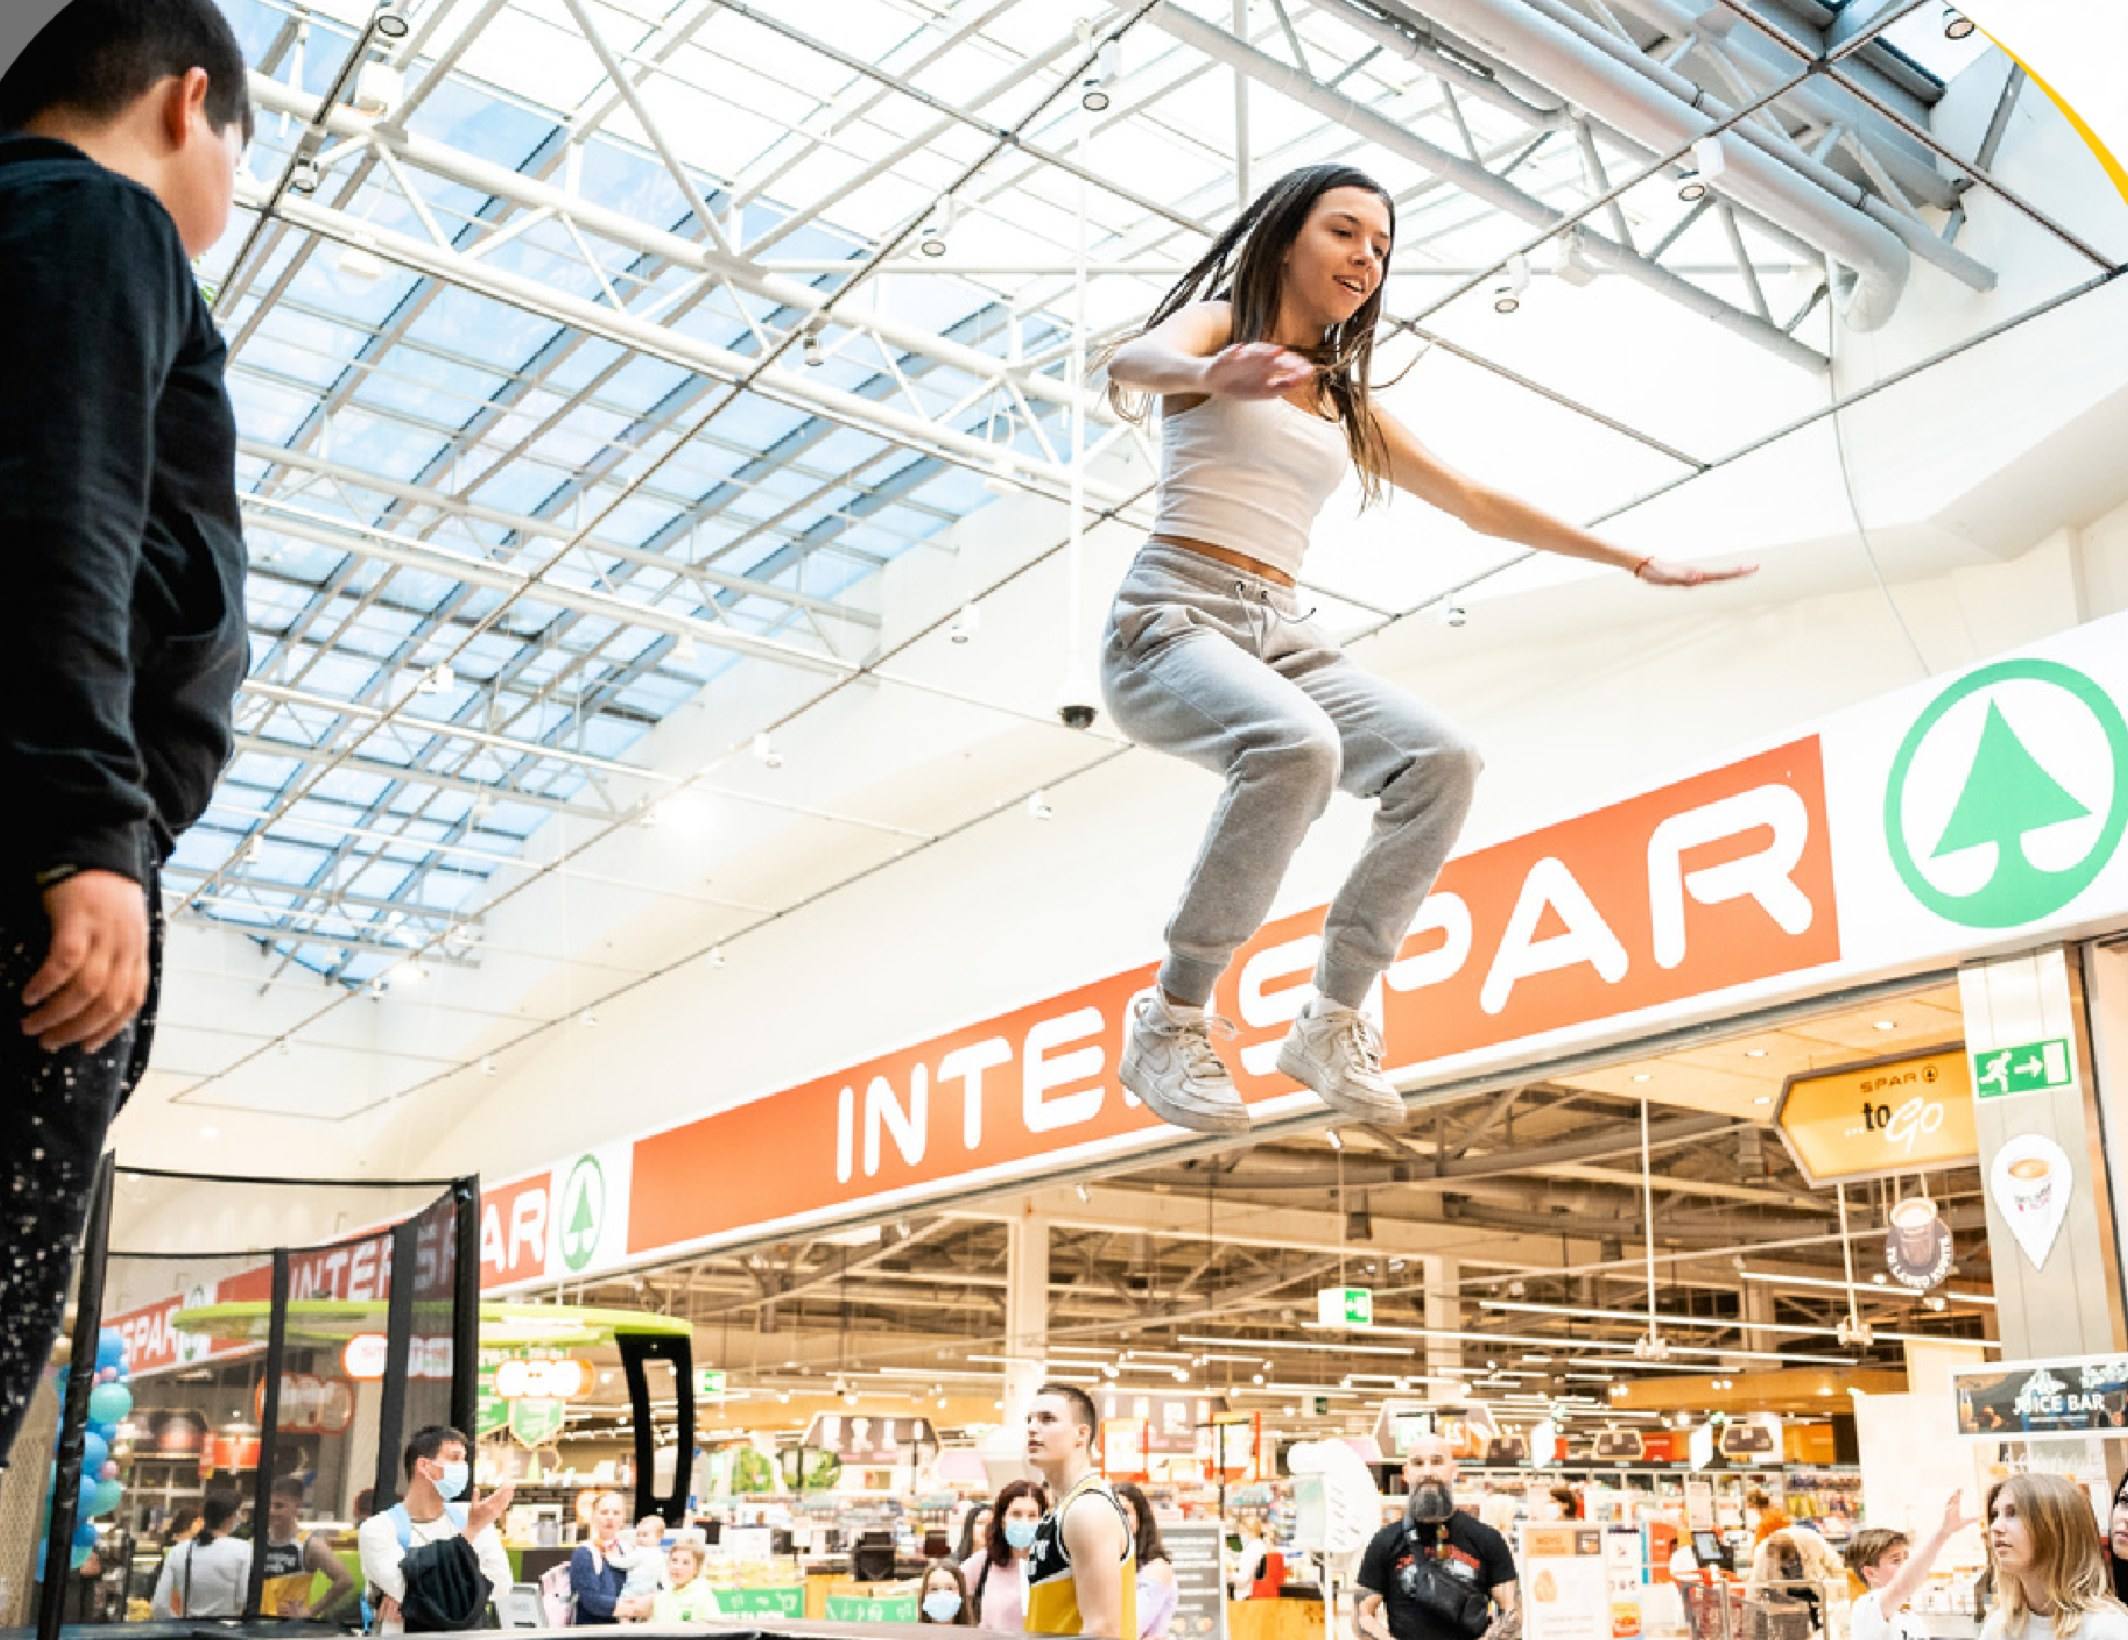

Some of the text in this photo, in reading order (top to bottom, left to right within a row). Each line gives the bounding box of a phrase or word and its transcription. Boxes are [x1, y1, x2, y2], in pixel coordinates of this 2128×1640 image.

[836, 783, 1813, 1184] INTESPAR
[1860, 1073, 1917, 1093] SPAR
[2013, 1393, 2105, 1415] JUICE BAR
